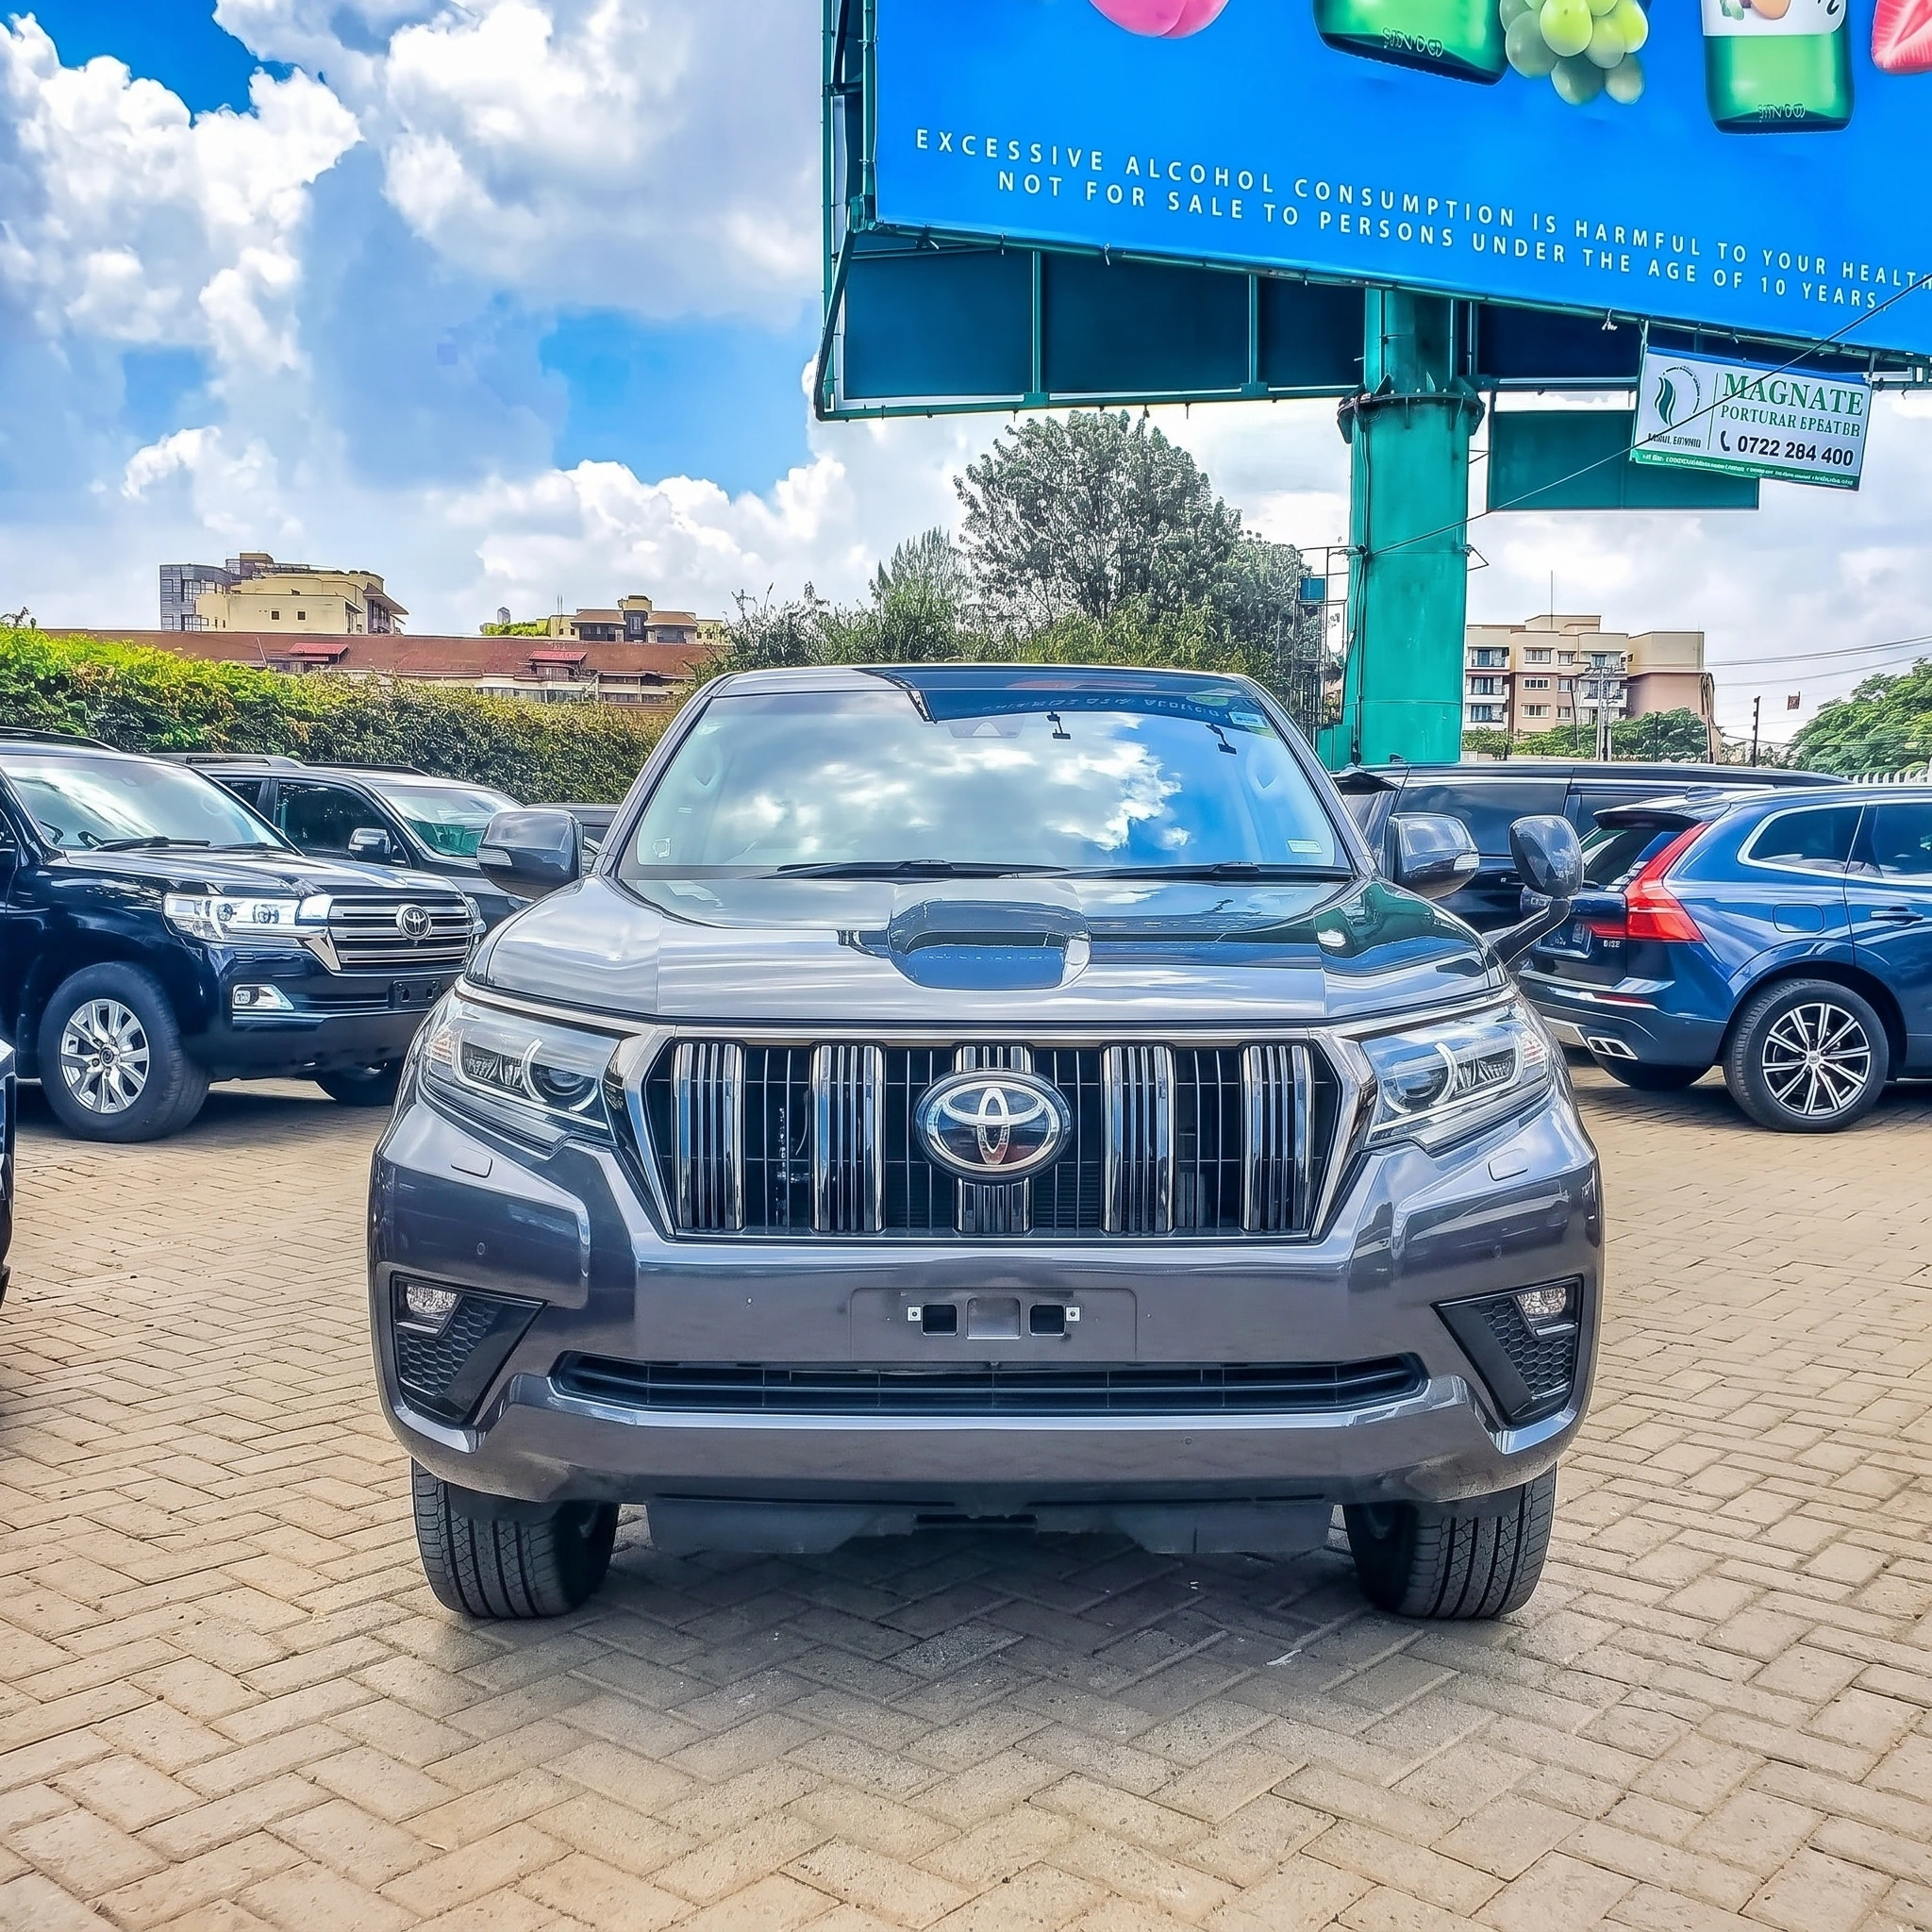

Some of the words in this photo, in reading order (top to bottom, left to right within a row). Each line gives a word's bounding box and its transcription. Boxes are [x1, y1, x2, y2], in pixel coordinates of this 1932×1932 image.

[916, 128, 1103, 172] EXCESSIVE
[1125, 156, 1274, 193] ALCOHOL
[1293, 177, 1514, 227] CONSUMPTION
[1532, 212, 1557, 234] IS
[1574, 220, 1701, 257] HARMFUL
[1717, 242, 1747, 263] TO
[1762, 250, 1826, 275] YOUR
[999, 171, 1063, 197] NOT
[1086, 181, 1145, 208] FOR
[1167, 191, 1243, 220] SALE
[1262, 202, 1299, 226] TO
[1320, 210, 1454, 247] PERSONS
[1472, 233, 1565, 264] UNDER
[1581, 248, 1631, 274] THE
[1647, 259, 1696, 283] AGE
[1712, 269, 1743, 290] OF
[1723, 373, 1864, 416] MAGNATE
[1737, 435, 1781, 458] 0722
[1784, 441, 1817, 462] 284
[1821, 447, 1855, 467] 400
